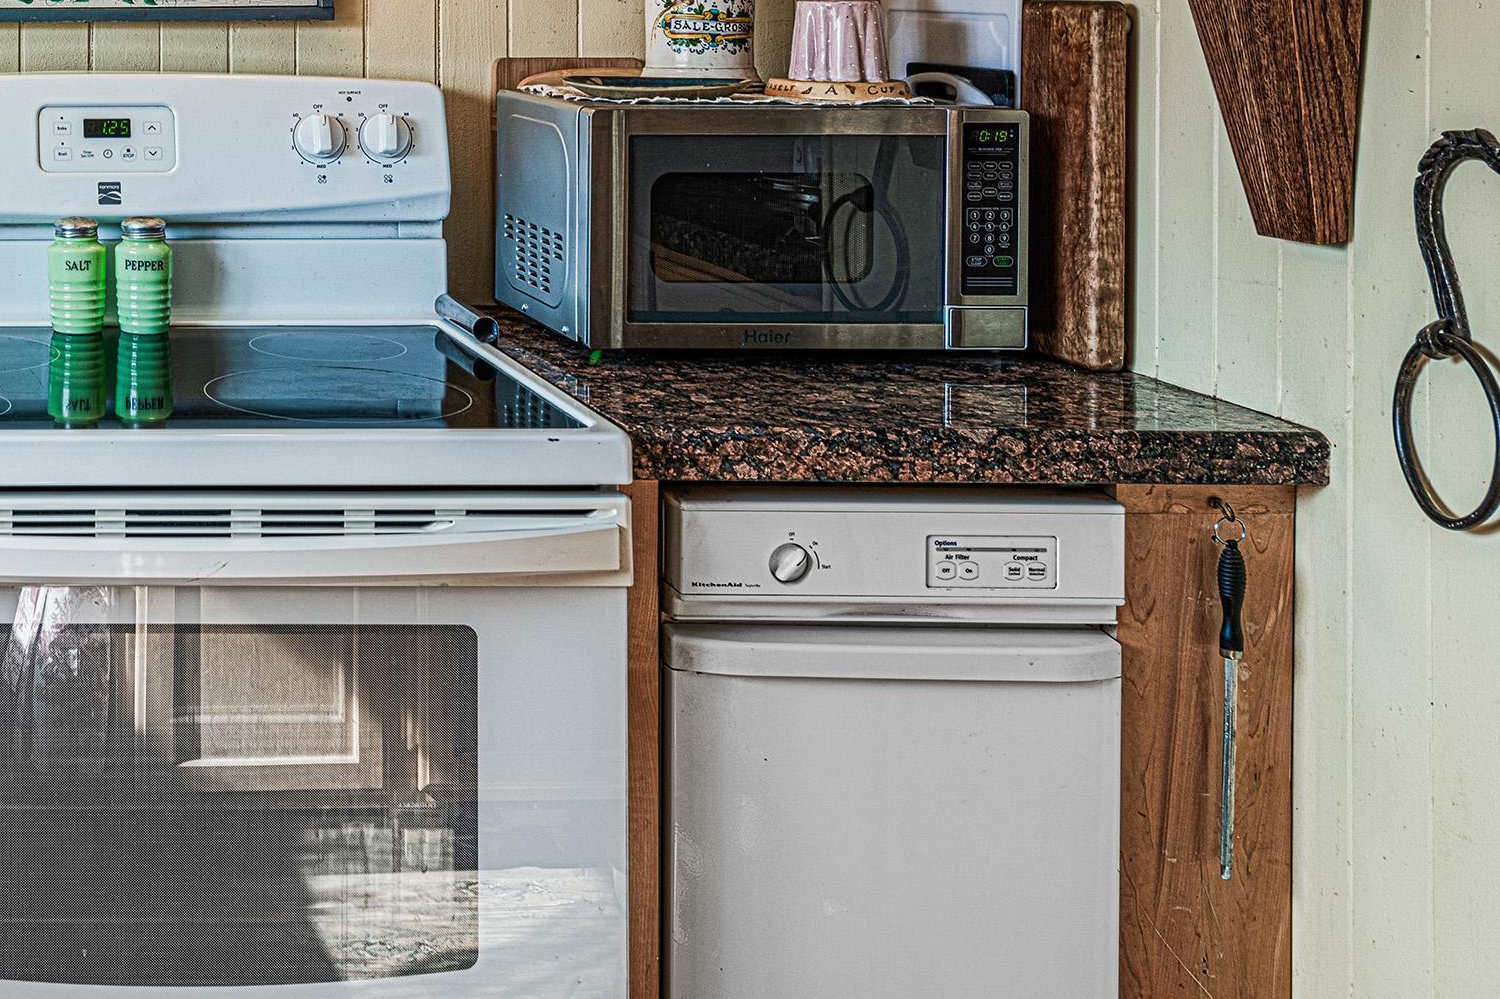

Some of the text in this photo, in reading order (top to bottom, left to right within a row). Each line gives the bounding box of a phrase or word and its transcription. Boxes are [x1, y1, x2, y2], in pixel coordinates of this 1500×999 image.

[825, 85, 838, 96] A
[65, 260, 164, 272] SALT PEPPER
[744, 329, 790, 344] Haier
